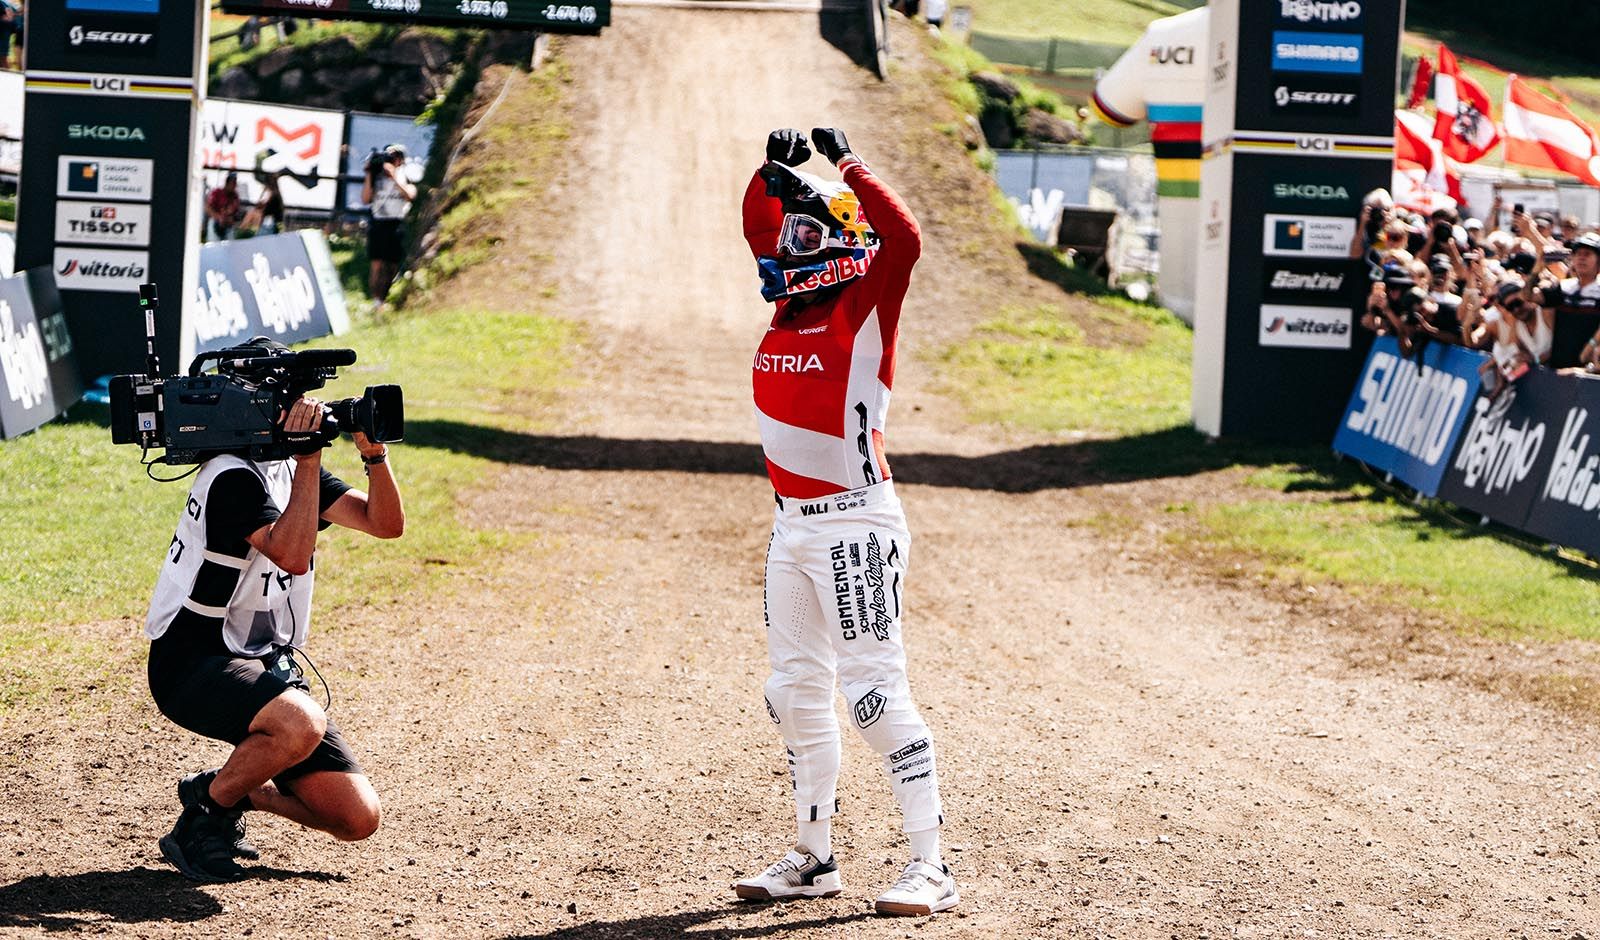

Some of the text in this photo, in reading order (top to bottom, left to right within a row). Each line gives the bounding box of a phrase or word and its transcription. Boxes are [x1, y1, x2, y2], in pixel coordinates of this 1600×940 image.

[84, 31, 153, 44] SCOTT
[1157, 46, 1194, 65] UCI
[1276, 44, 1360, 62] SHIMANO
[92, 78, 125, 91] UCI
[1290, 91, 1356, 105] SCOTT
[1298, 138, 1330, 151] UCI
[68, 219, 137, 234] TISSOT
[78, 260, 144, 279] vittoria
[784, 259, 838, 295] Red
[1270, 269, 1344, 291] Santini
[1285, 317, 1348, 336] vittoria
[752, 351, 825, 373] USTRIA
[1346, 351, 1468, 466] SHIMANO
[800, 502, 829, 516] VALI
[864, 532, 893, 641] Troy Lee Designs
[854, 584, 871, 634] SCHWALBE
